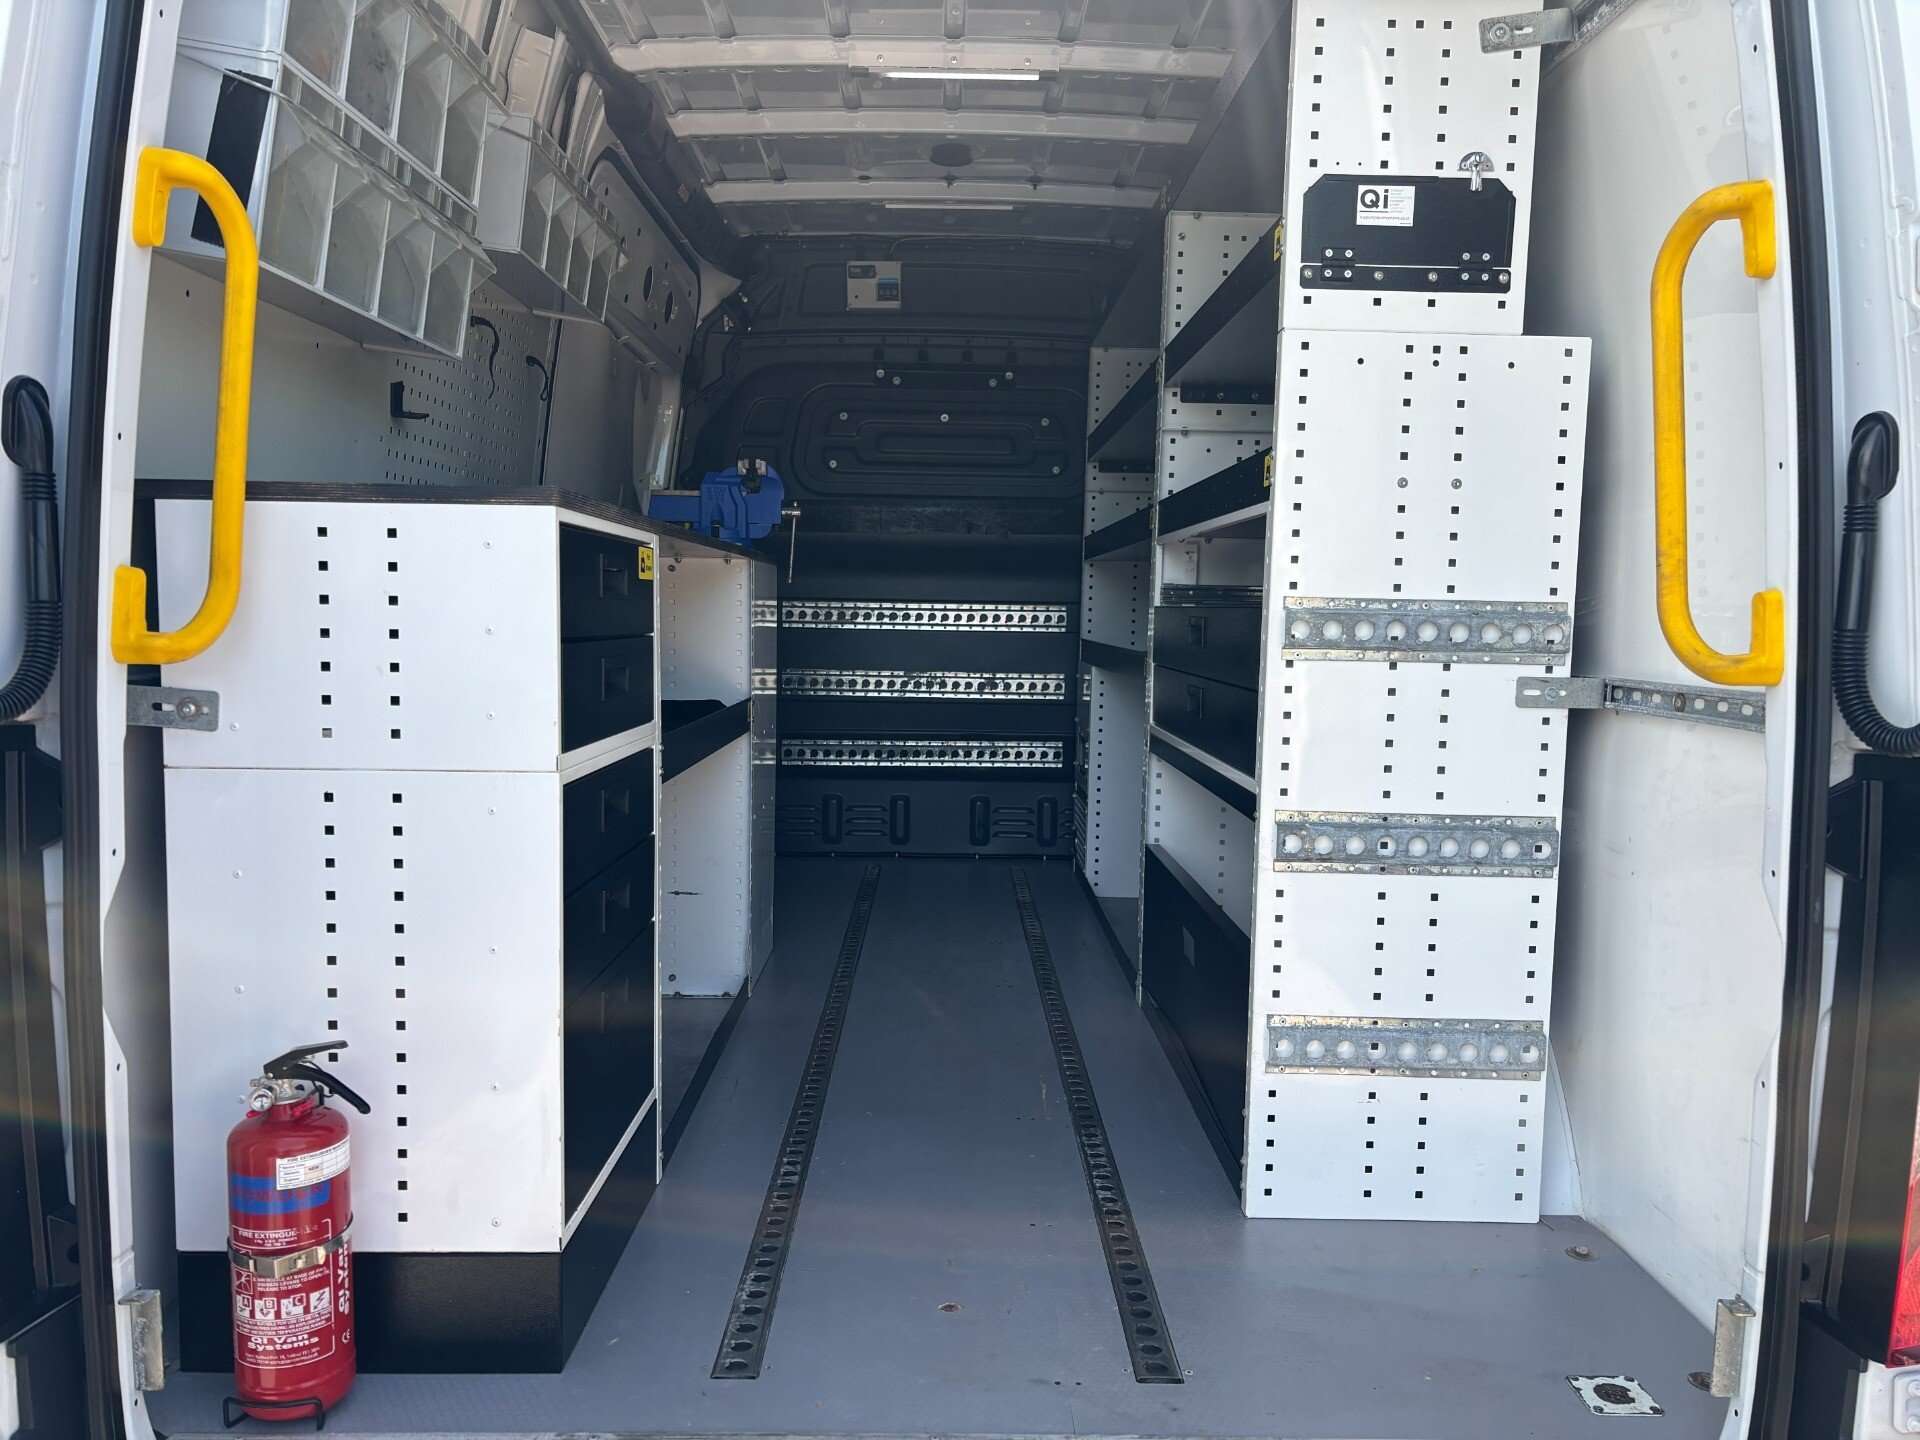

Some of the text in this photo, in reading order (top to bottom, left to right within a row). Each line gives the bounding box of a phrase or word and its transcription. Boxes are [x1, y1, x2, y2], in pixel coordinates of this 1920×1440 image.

[1360, 189, 1389, 209] Qi
[238, 1230, 253, 1238] FIRE
[243, 1297, 249, 1307] A
[265, 1299, 273, 1309] B
[295, 1296, 302, 1305] C
[247, 1336, 320, 1352] Systems
[272, 1334, 309, 1344] Van
